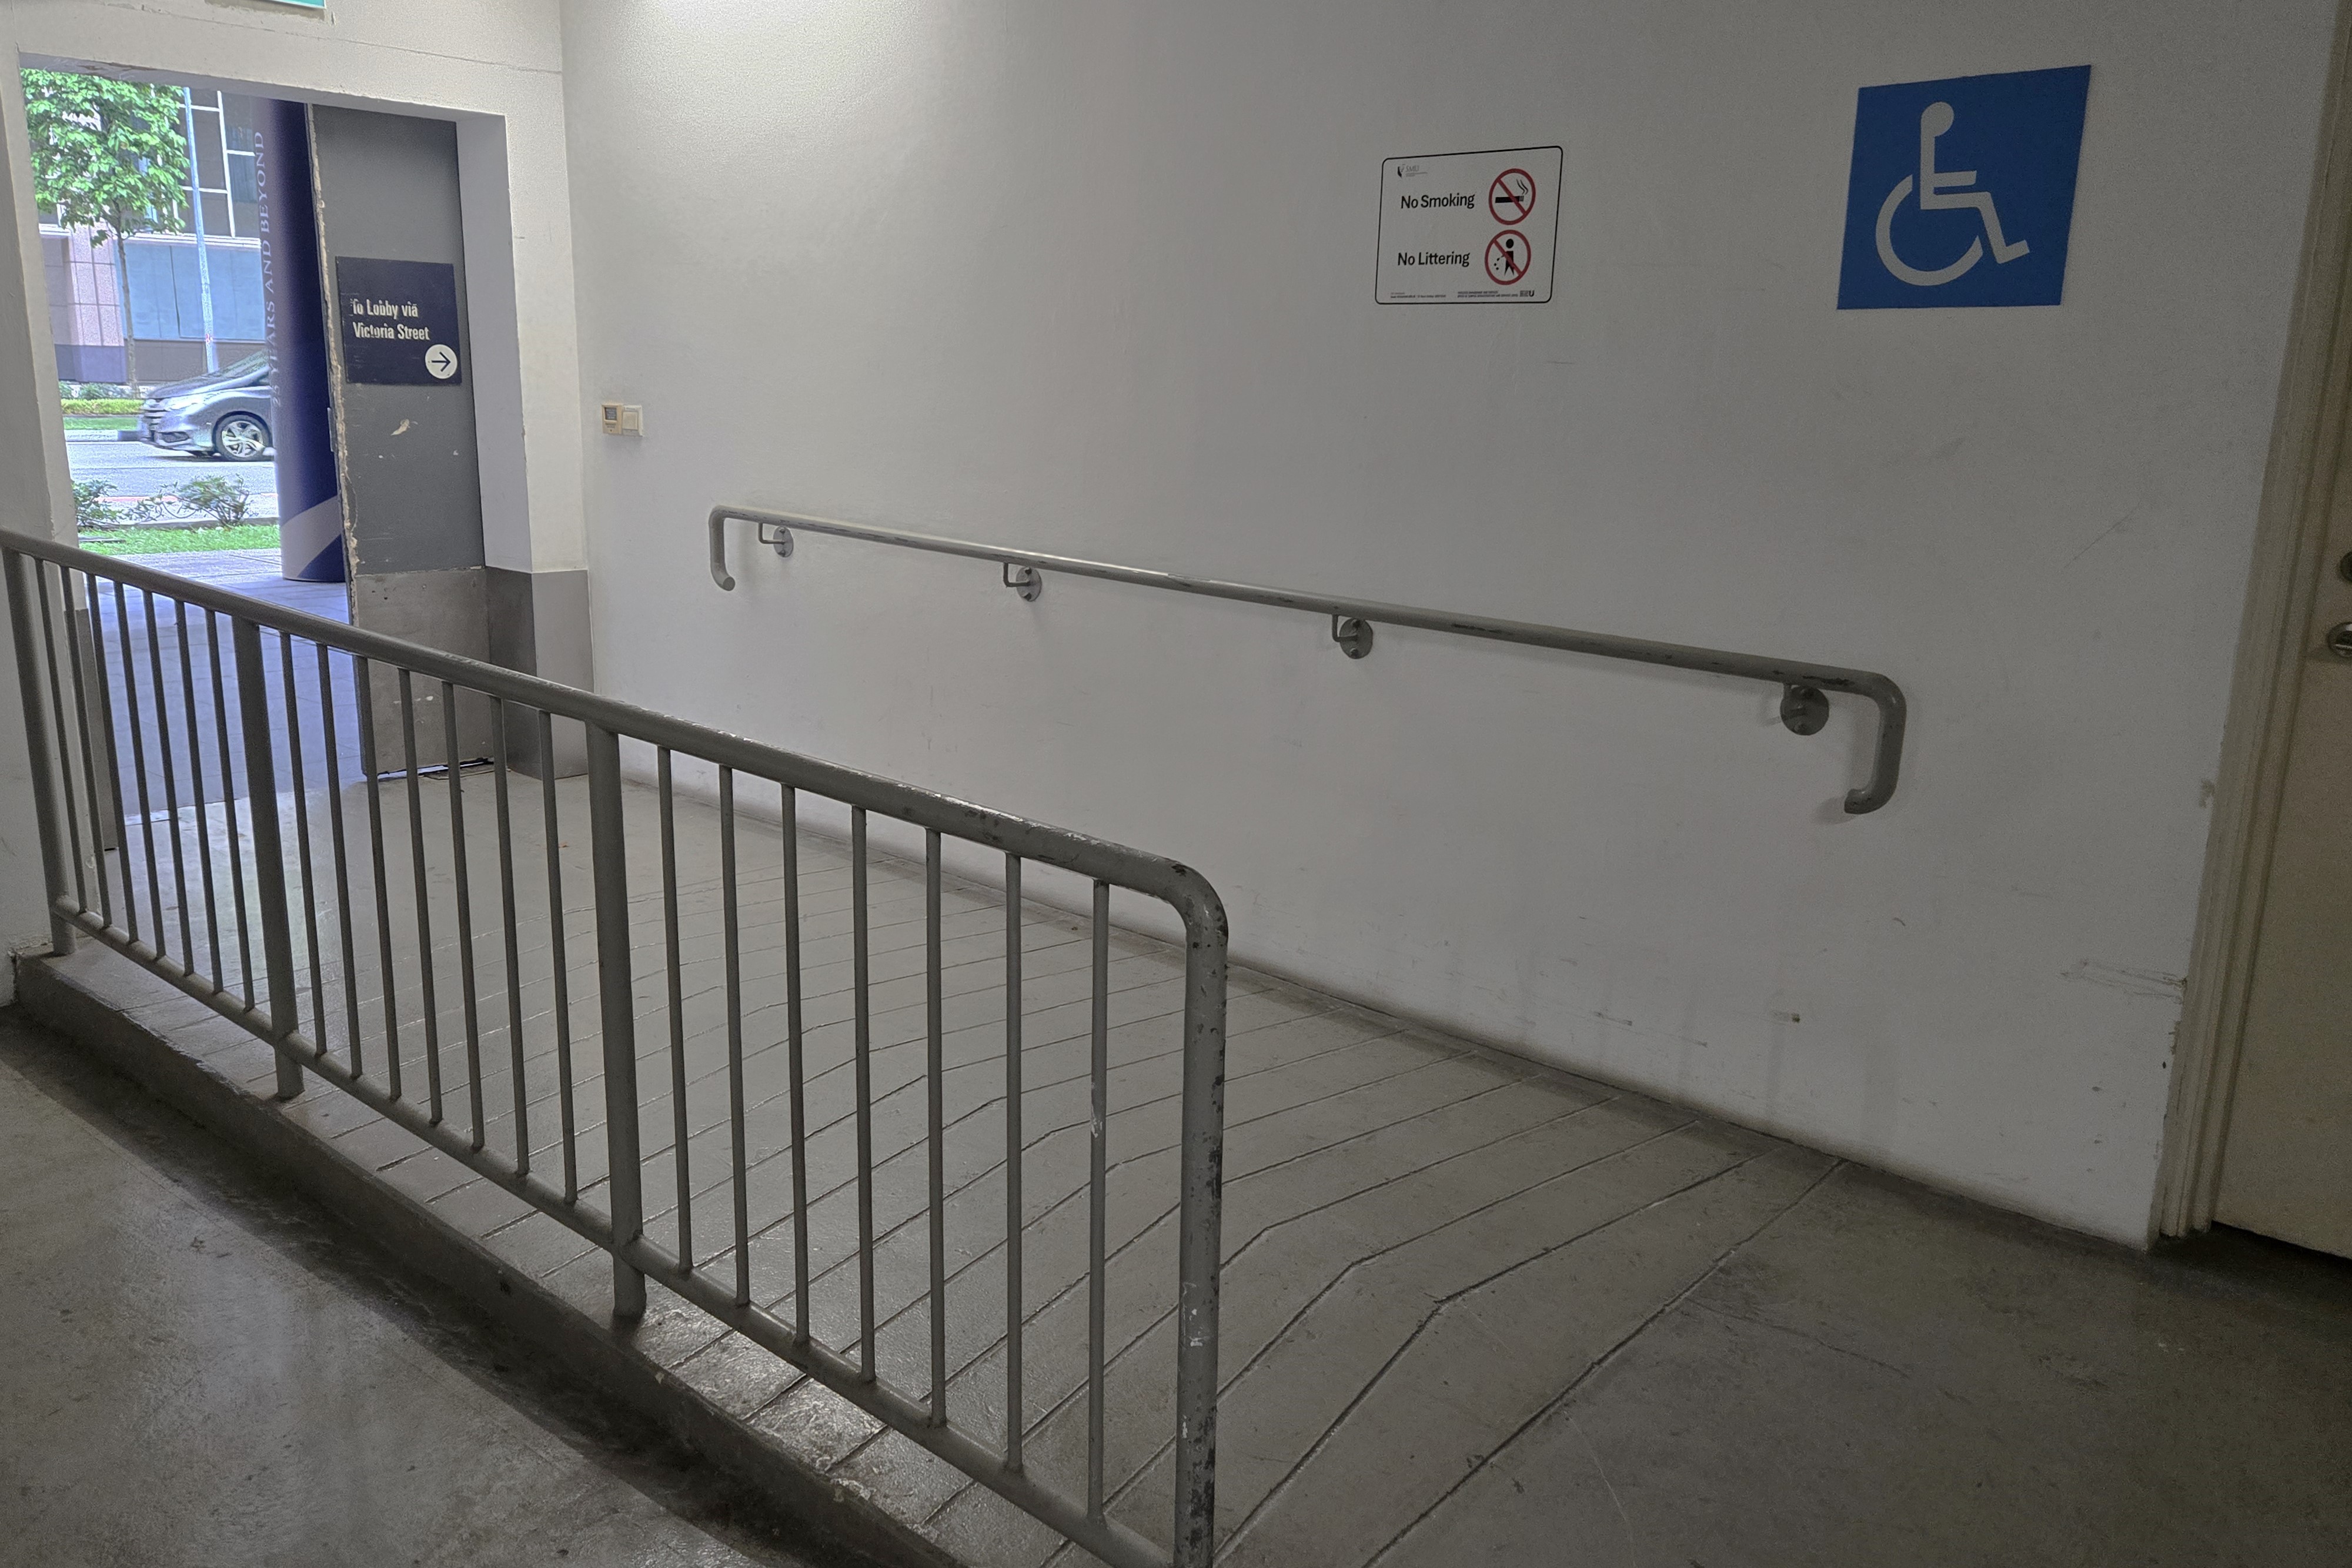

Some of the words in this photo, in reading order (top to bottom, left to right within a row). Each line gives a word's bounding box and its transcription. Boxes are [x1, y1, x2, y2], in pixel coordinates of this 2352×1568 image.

[255, 132, 270, 233] BEYOND
[1401, 195, 1418, 209] No
[1421, 192, 1475, 209] Smoking
[262, 240, 274, 293] AND
[1398, 252, 1415, 266] No
[1418, 251, 1471, 268] Littering
[350, 298, 363, 315] To
[366, 299, 398, 320] Lobby
[401, 300, 419, 317] via
[352, 321, 395, 339] Victoria
[396, 323, 430, 340] Street
